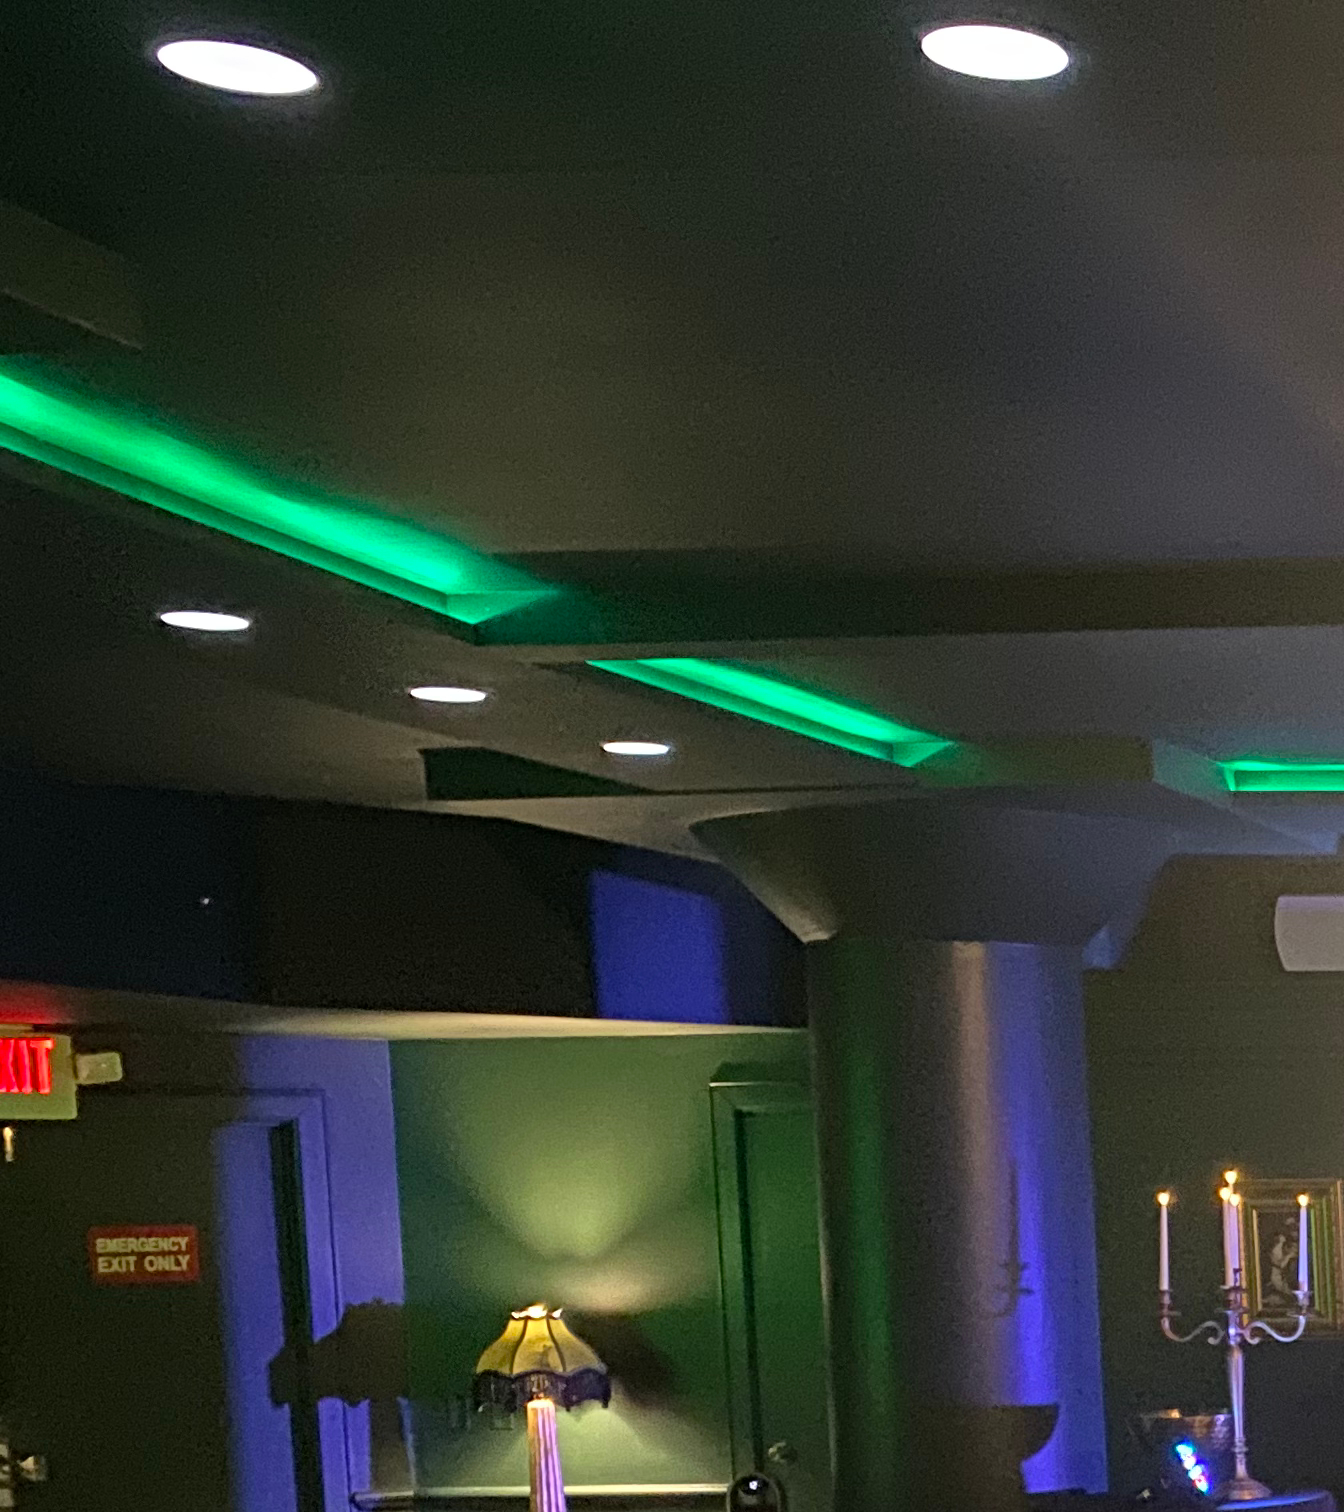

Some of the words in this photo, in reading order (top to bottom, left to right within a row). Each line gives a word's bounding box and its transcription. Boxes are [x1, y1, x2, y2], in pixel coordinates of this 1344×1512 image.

[0, 1039, 53, 1094] XIT
[96, 1237, 188, 1253] EMERGENCY
[98, 1255, 137, 1272] EXIT
[144, 1254, 190, 1272] ONLY
